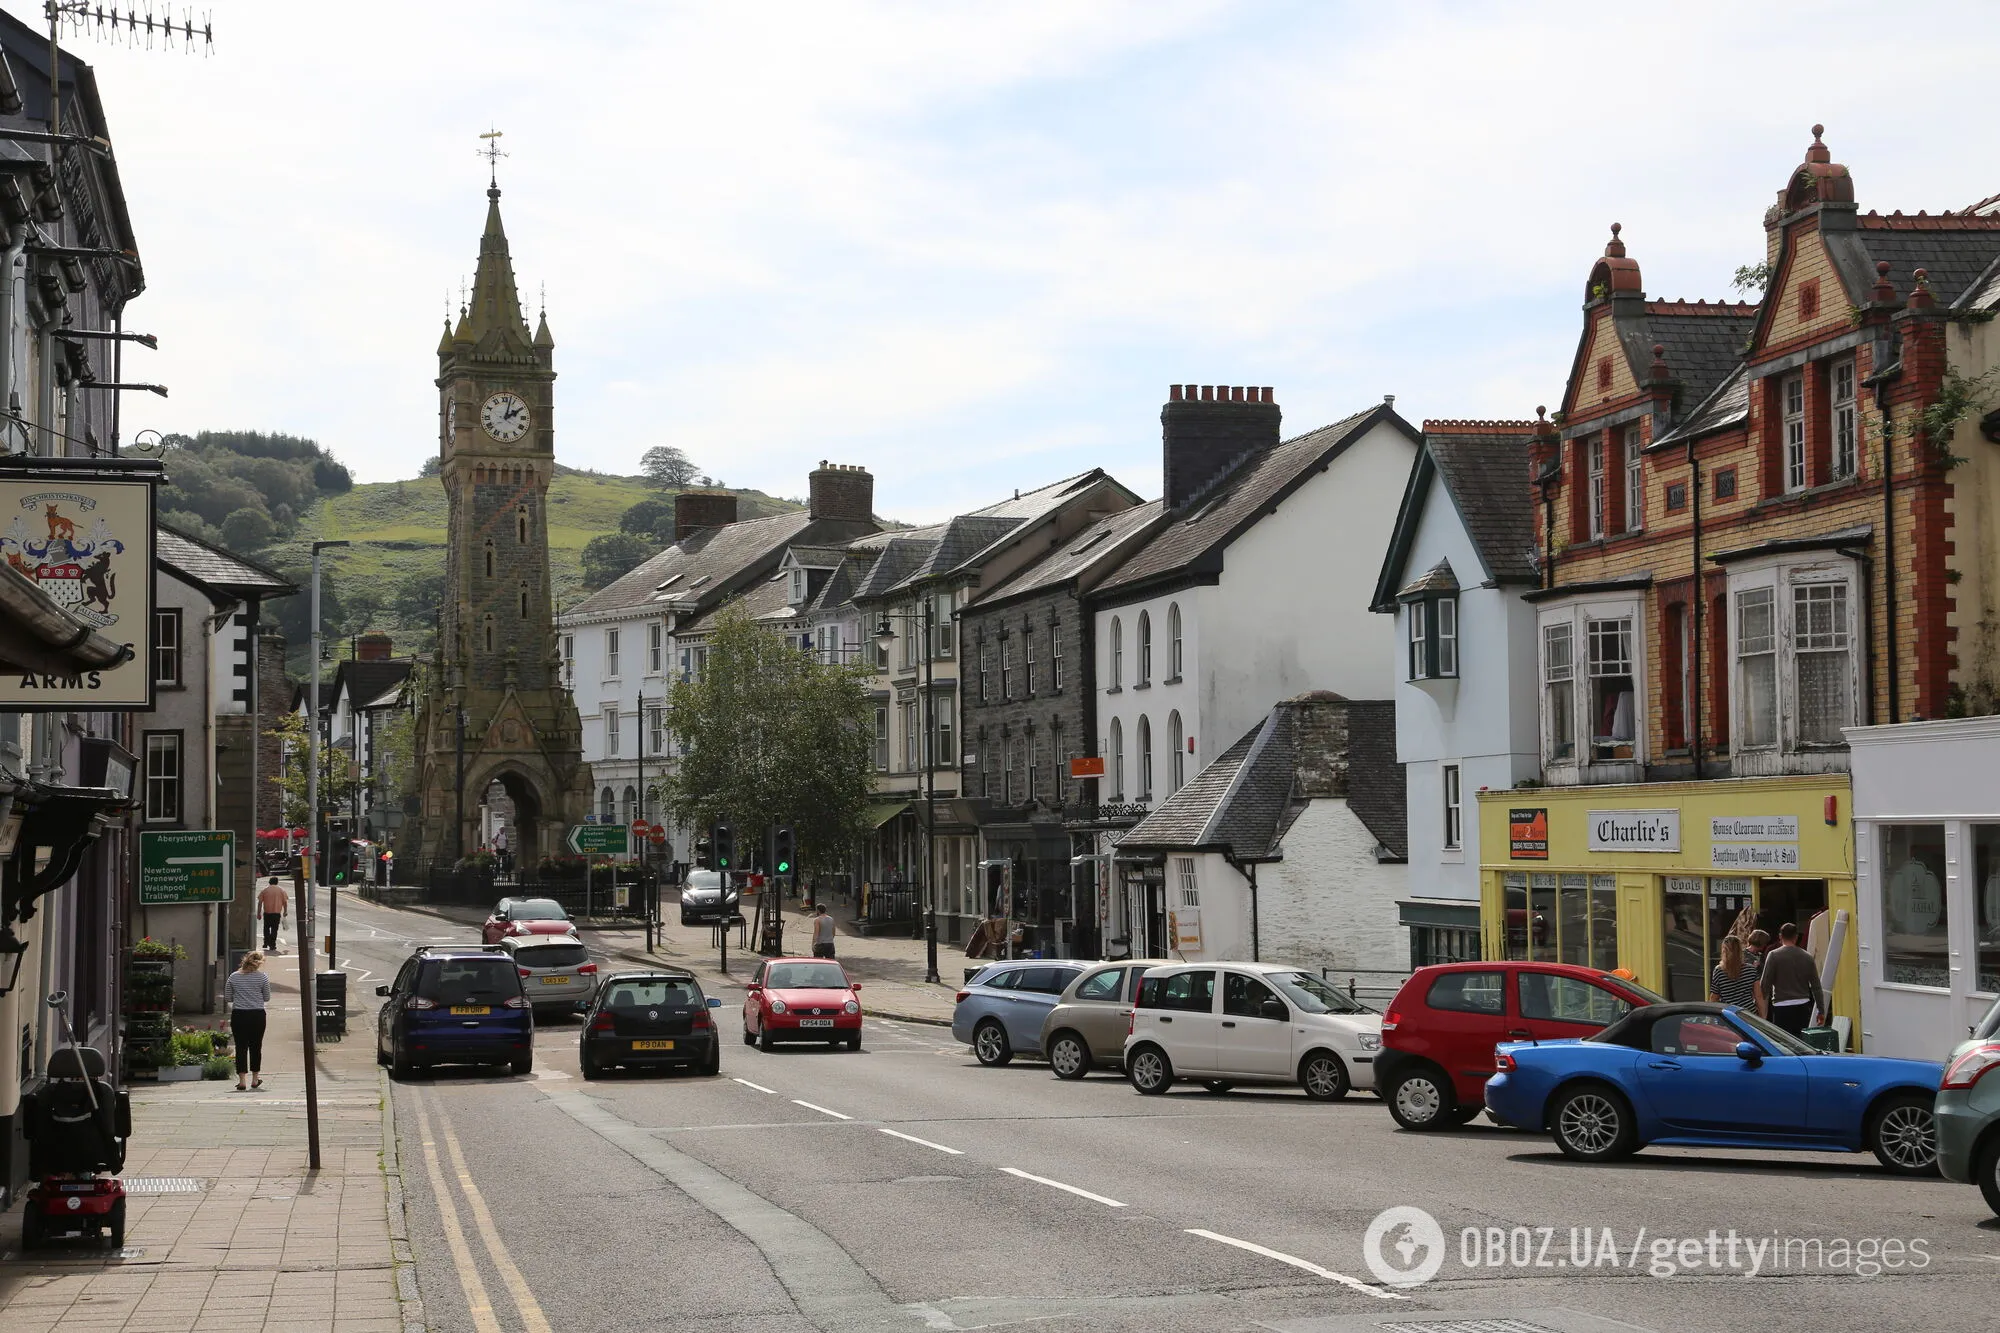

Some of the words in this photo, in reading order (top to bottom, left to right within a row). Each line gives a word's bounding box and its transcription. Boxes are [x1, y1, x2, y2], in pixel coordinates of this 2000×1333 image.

[20, 671, 102, 689] ARMS
[1598, 818, 1669, 842] Charlie's
[1713, 820, 1732, 835] House
[1734, 820, 1764, 835] Clearance
[157, 835, 206, 843] Aberystwyth
[1713, 848, 1738, 865] Anything
[1739, 848, 1749, 863] Old
[1751, 848, 1772, 865] Bought
[1781, 848, 1796, 863] Sold
[144, 884, 186, 892] Welshpool
[1671, 878, 1700, 891] Tools
[1715, 879, 1746, 894] Fishing
